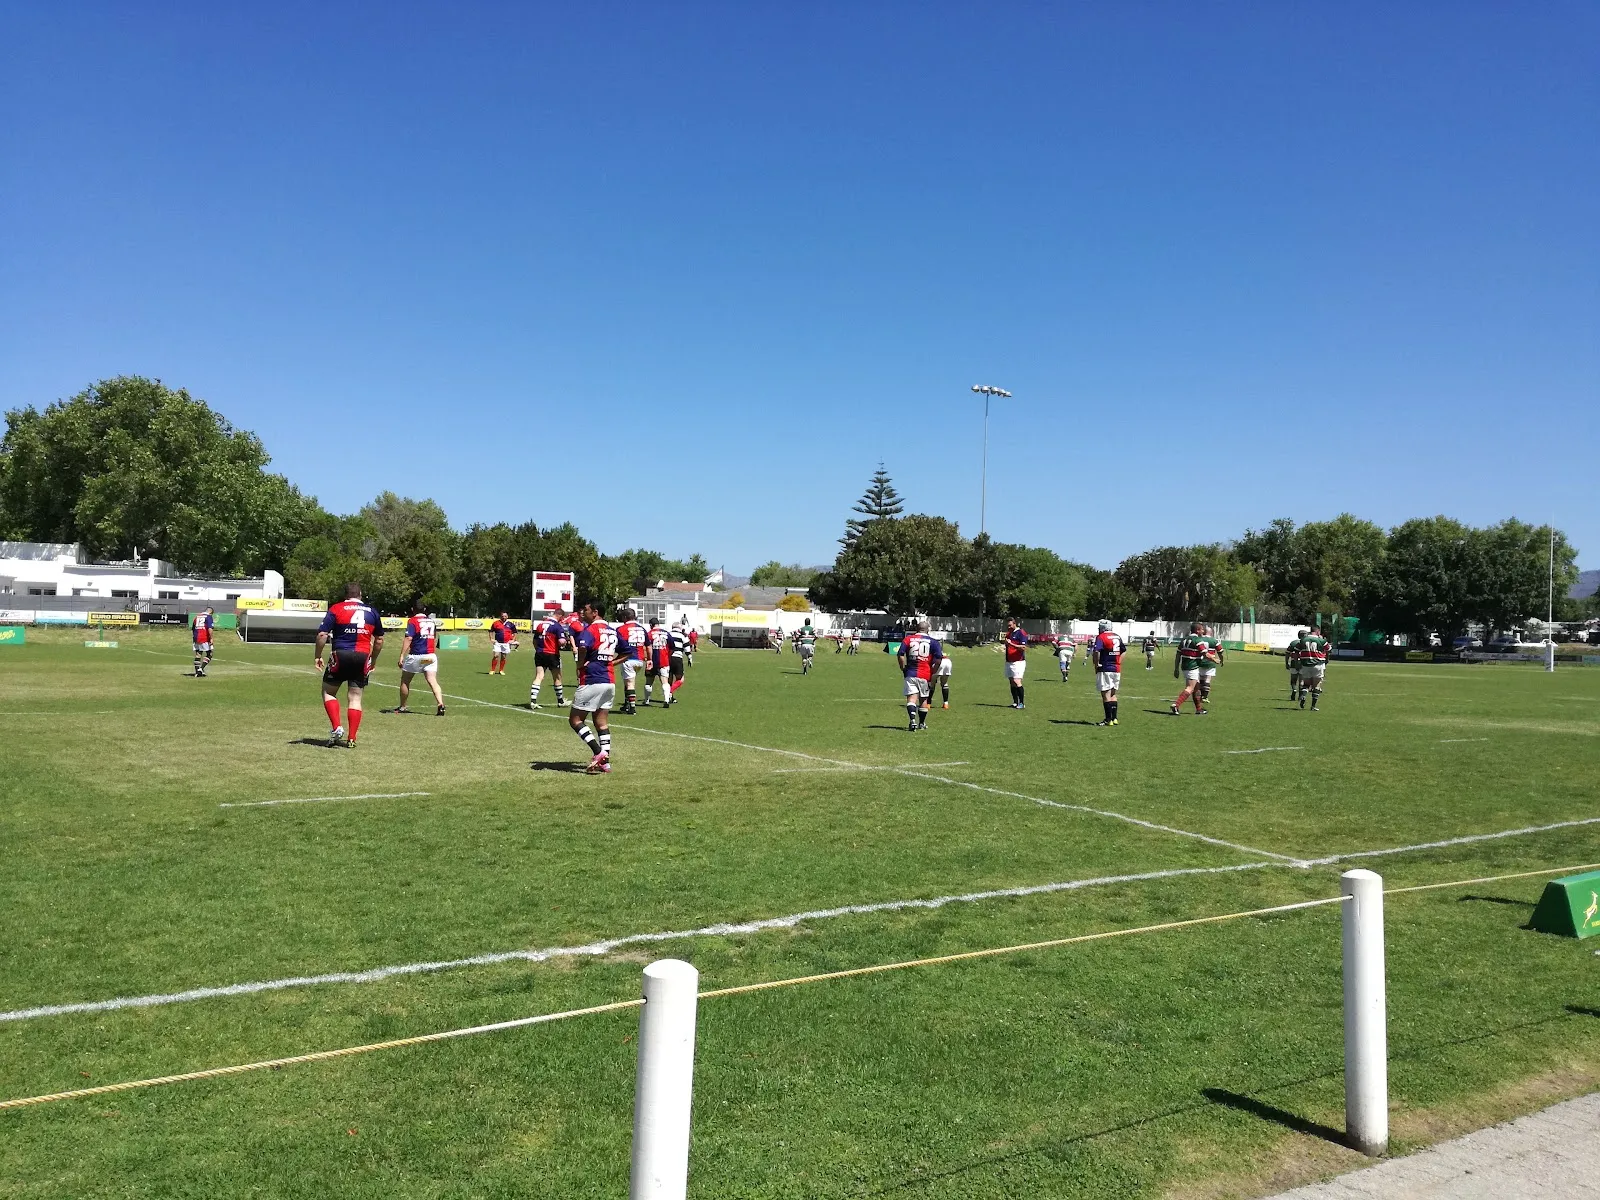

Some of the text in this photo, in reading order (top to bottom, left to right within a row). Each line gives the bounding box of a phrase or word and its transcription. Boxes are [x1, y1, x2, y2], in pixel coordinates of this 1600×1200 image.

[195, 617, 206, 627] 12
[350, 610, 366, 629] 4
[628, 631, 646, 643] 25
[597, 633, 618, 656] 22
[908, 641, 931, 658] 20
[1112, 638, 1121, 652] 2
[1305, 641, 1318, 653] 10
